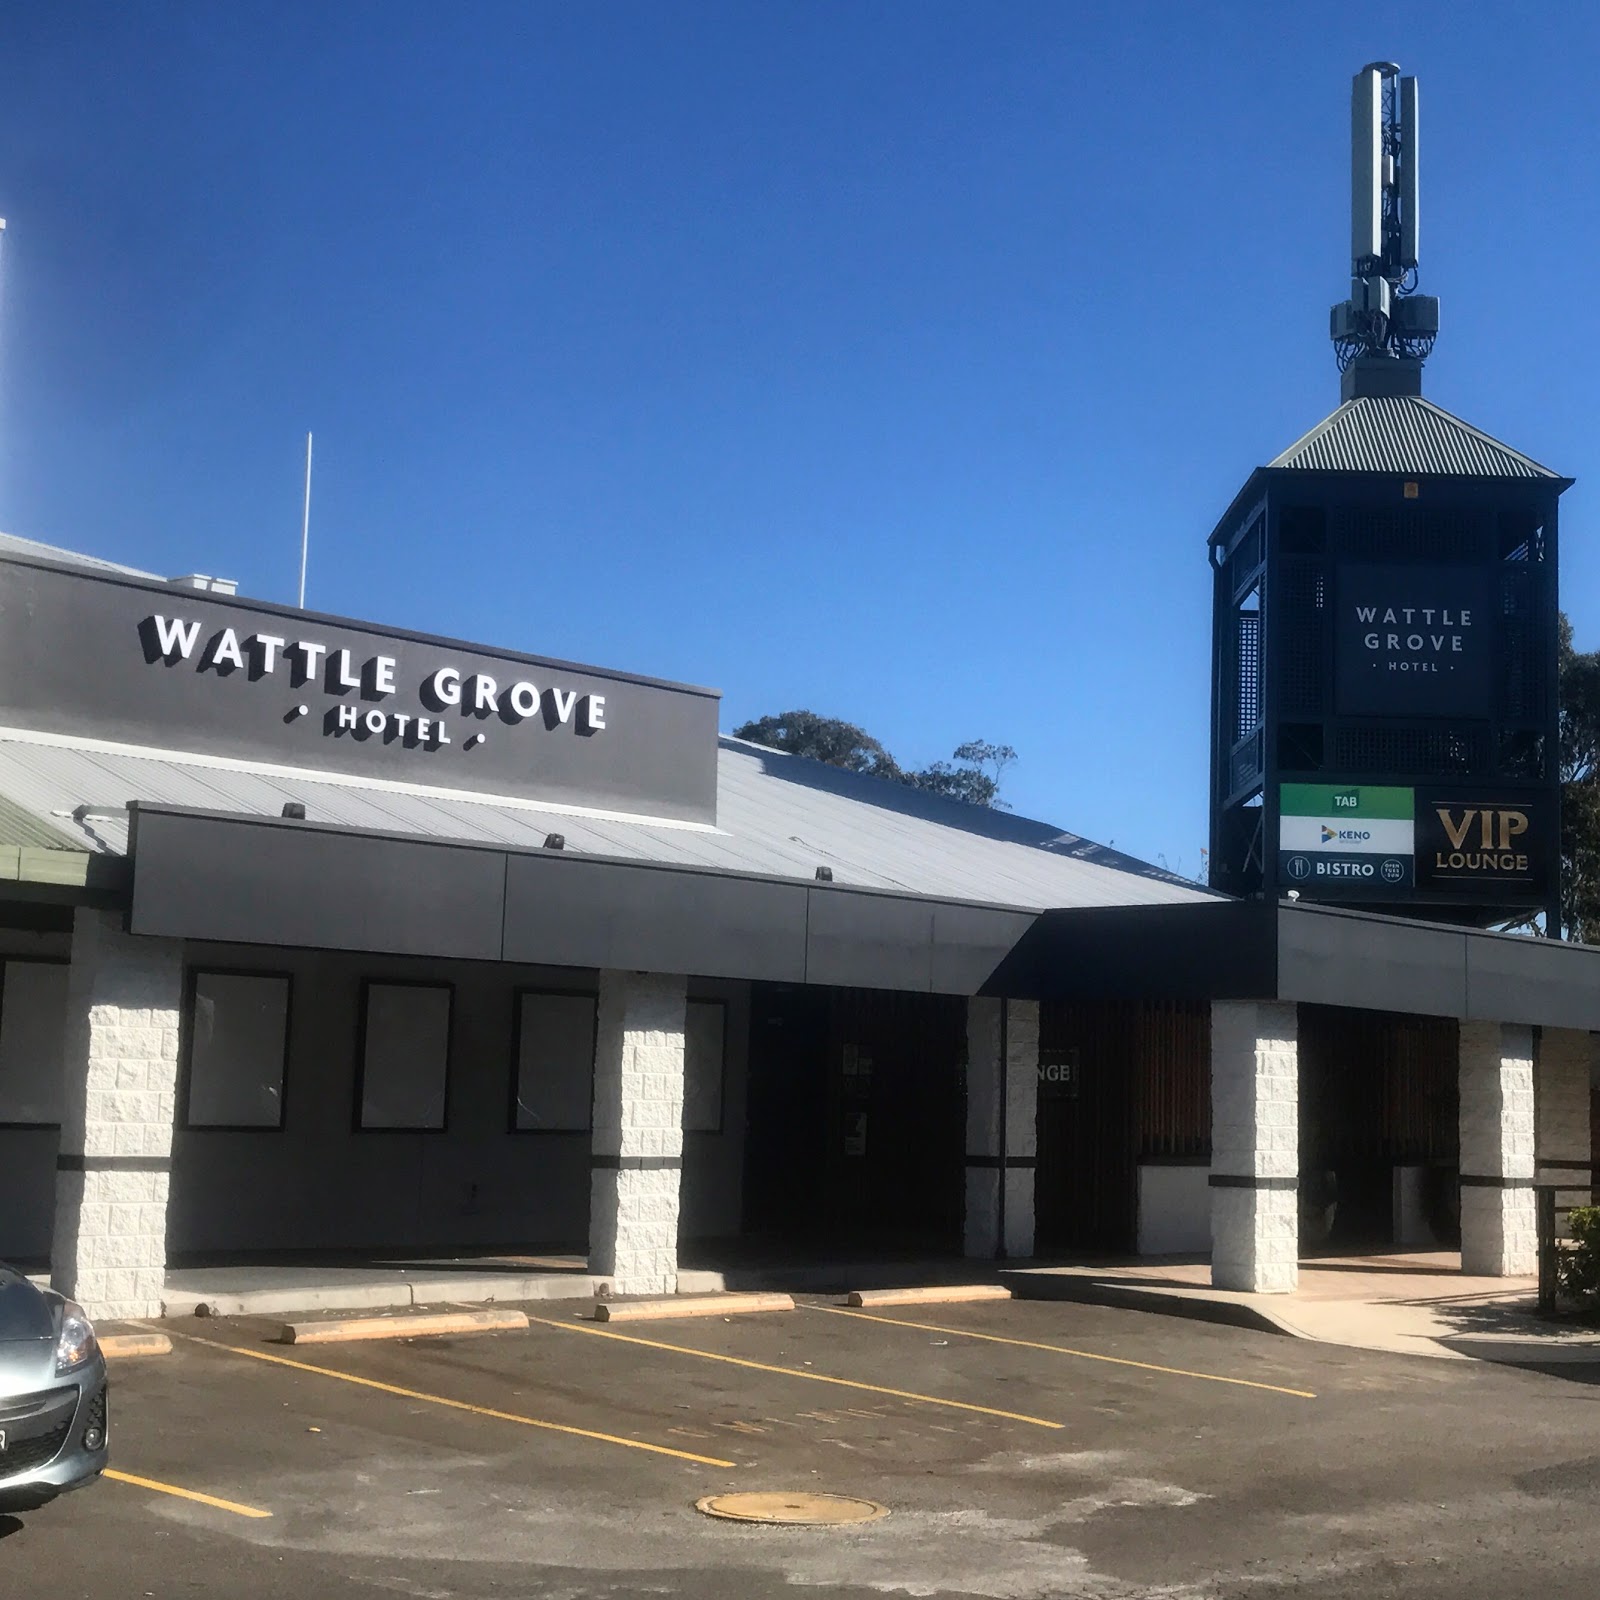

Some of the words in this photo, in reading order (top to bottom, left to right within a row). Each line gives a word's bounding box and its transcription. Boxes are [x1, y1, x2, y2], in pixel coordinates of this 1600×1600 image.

[1356, 606, 1472, 626] WATTLE
[1364, 633, 1463, 652] GROVE
[154, 615, 396, 694] WATTLE
[433, 667, 606, 730] GROVE
[1388, 661, 1438, 672] HOTEL
[338, 704, 451, 745] HOTEL
[1334, 796, 1358, 807] TAB
[1338, 830, 1371, 840] KENO
[1435, 808, 1529, 850] VIP
[1316, 861, 1375, 877] BISTRO
[1436, 852, 1529, 871] LOUNGE
